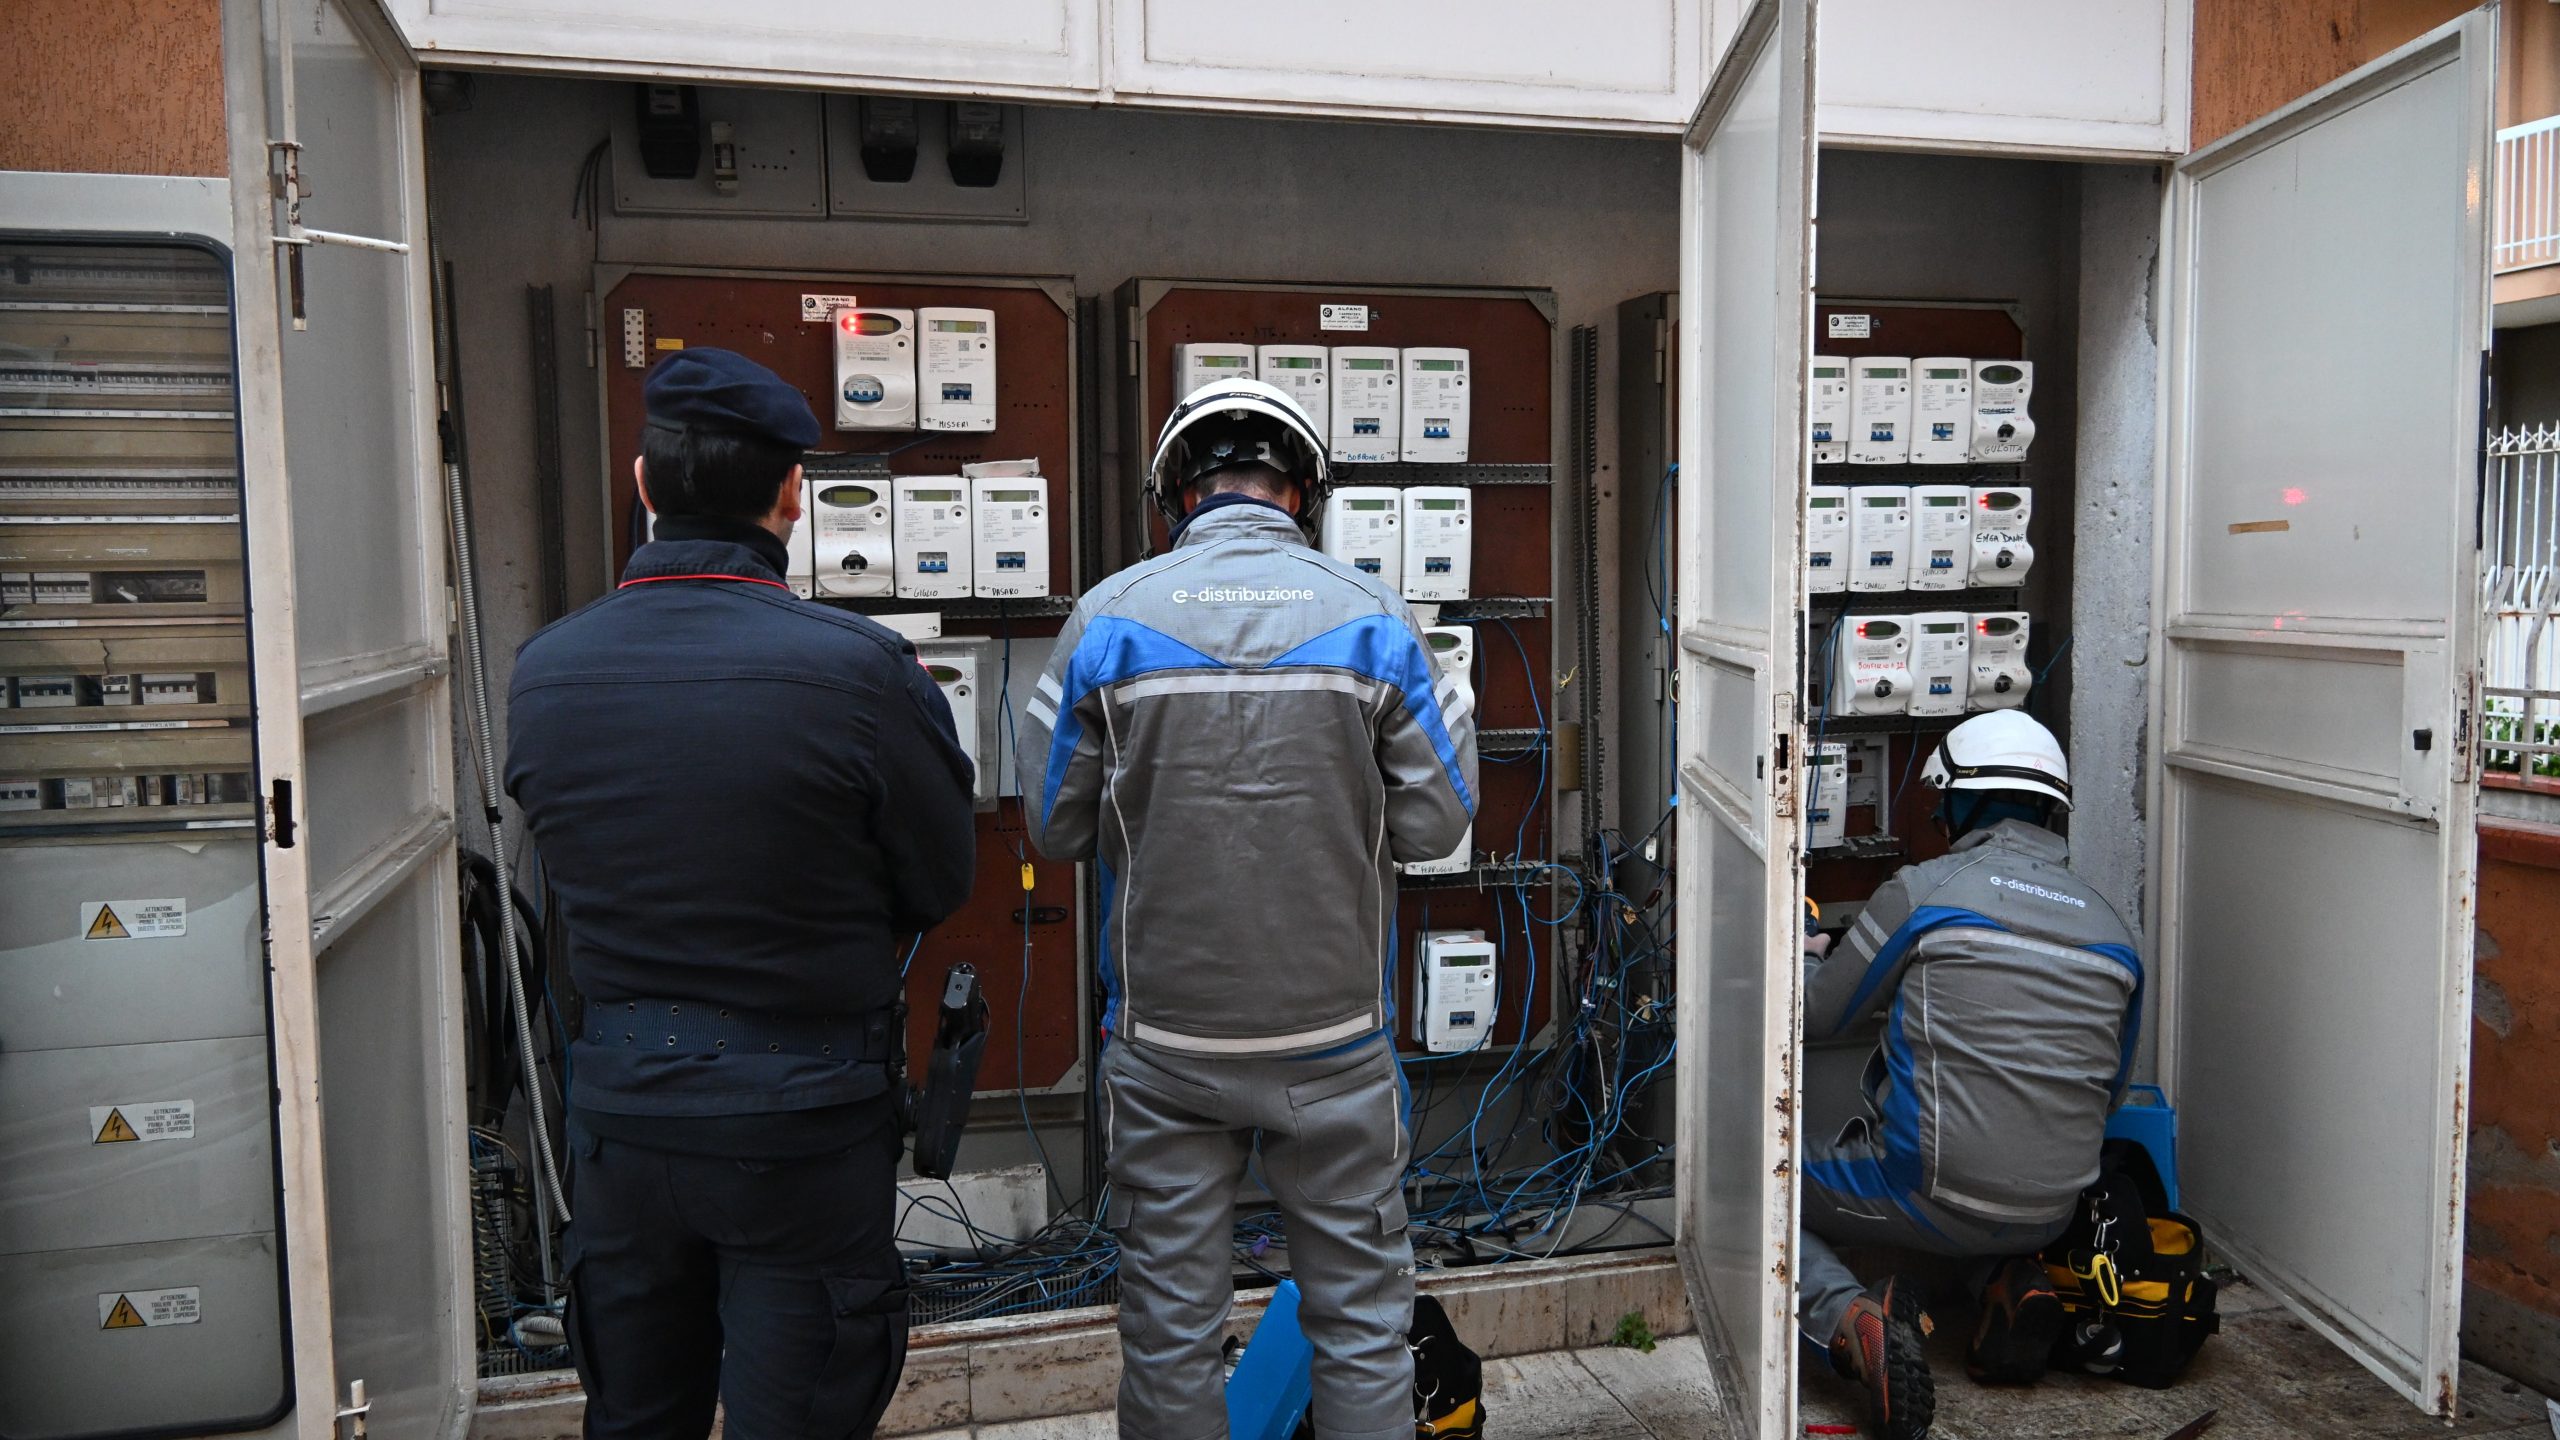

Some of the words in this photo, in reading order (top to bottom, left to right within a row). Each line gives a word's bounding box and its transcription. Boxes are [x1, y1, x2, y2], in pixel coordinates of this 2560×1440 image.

[939, 421, 969, 429] MISSERI
[1172, 586, 1314, 604] e-distribuzione
[1990, 876, 2086, 908] e-distribuzione
